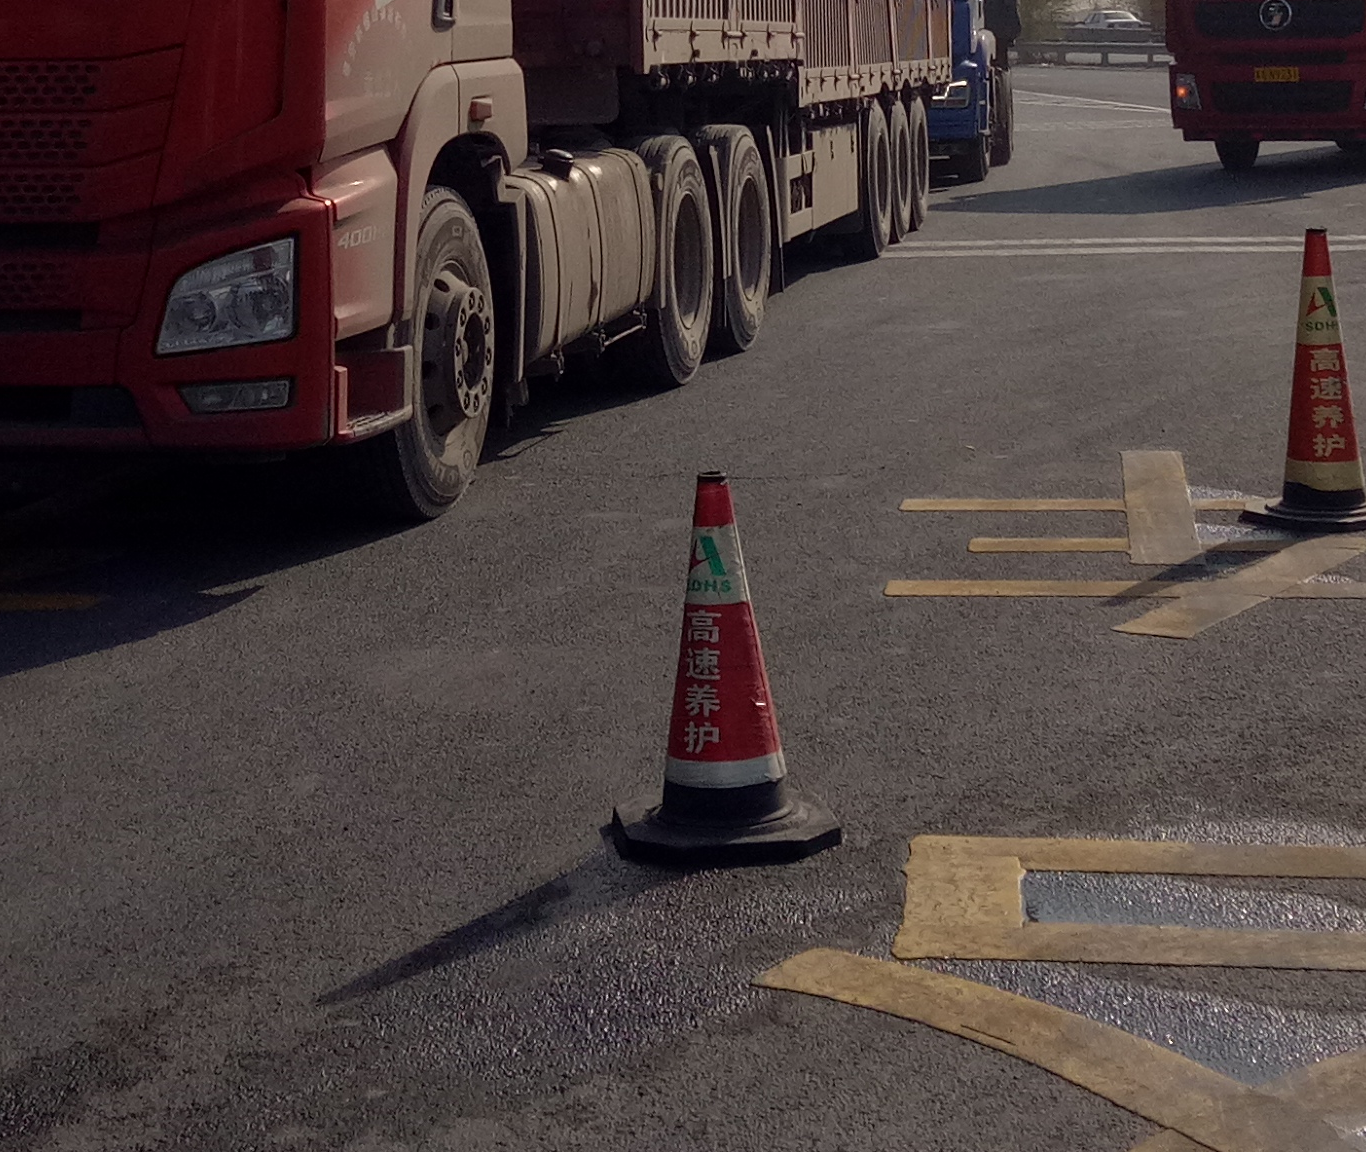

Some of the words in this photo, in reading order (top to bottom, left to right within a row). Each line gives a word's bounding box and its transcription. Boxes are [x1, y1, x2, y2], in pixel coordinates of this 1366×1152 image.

[1305, 320, 1339, 332] SDH
[1309, 347, 1346, 459] 高速养护
[686, 578, 732, 593] DHS
[684, 608, 722, 755] 高速养护
